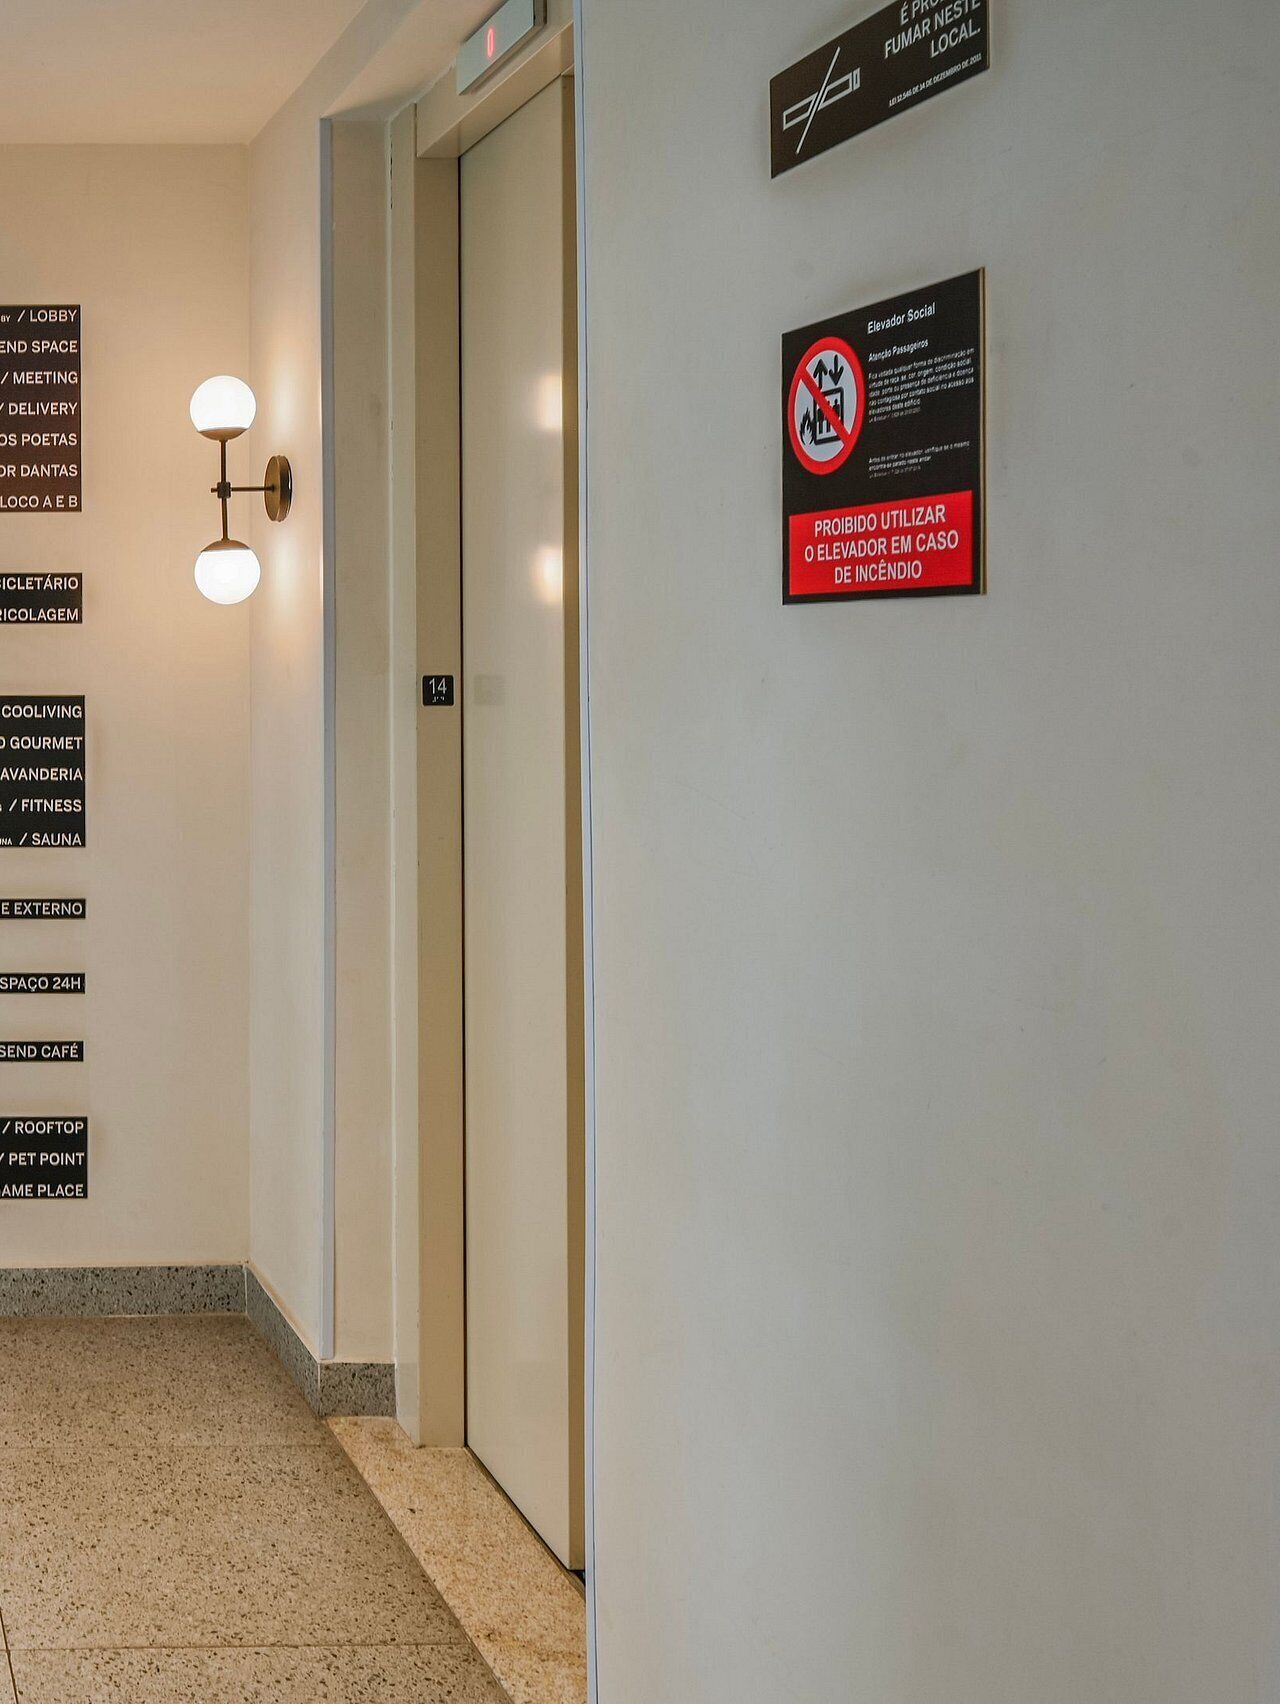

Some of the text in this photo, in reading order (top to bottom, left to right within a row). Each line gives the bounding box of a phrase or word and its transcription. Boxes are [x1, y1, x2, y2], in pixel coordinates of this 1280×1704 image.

[901, 2, 909, 26] É
[885, 18, 931, 59] FUMAR
[930, 19, 980, 58] LOCAL.
[29, 309, 76, 323] LOBBY
[867, 301, 936, 334] Elevador Social
[31, 339, 77, 354] SPACE
[868, 338, 928, 362] Atenção Passageiros
[13, 370, 77, 385] MEETING
[8, 401, 77, 416] DELIVERY
[21, 432, 77, 447] POETAS
[20, 463, 77, 478] DANTAS
[42, 494, 52, 509] A
[56, 494, 64, 508] E
[68, 494, 77, 508] B
[814, 504, 946, 537] PROIBIDO UTILIZAR
[805, 529, 959, 563] O ELEVADOR EM CASO
[834, 558, 922, 584] DE INCÊNDIO
[429, 677, 447, 695] 14
[1, 704, 82, 719] COOLIVING
[9, 735, 82, 750] GOURMET
[21, 798, 81, 813] FITNESS
[31, 832, 81, 846] SAUNA
[14, 901, 82, 916] EXTERNO
[52, 976, 80, 990] 24H
[41, 1042, 78, 1058] CAFÉ
[14, 1120, 83, 1135] ROOFTOP
[8, 1152, 36, 1166] PET
[39, 1152, 84, 1166] POINT
[37, 1183, 83, 1198] PLACE
